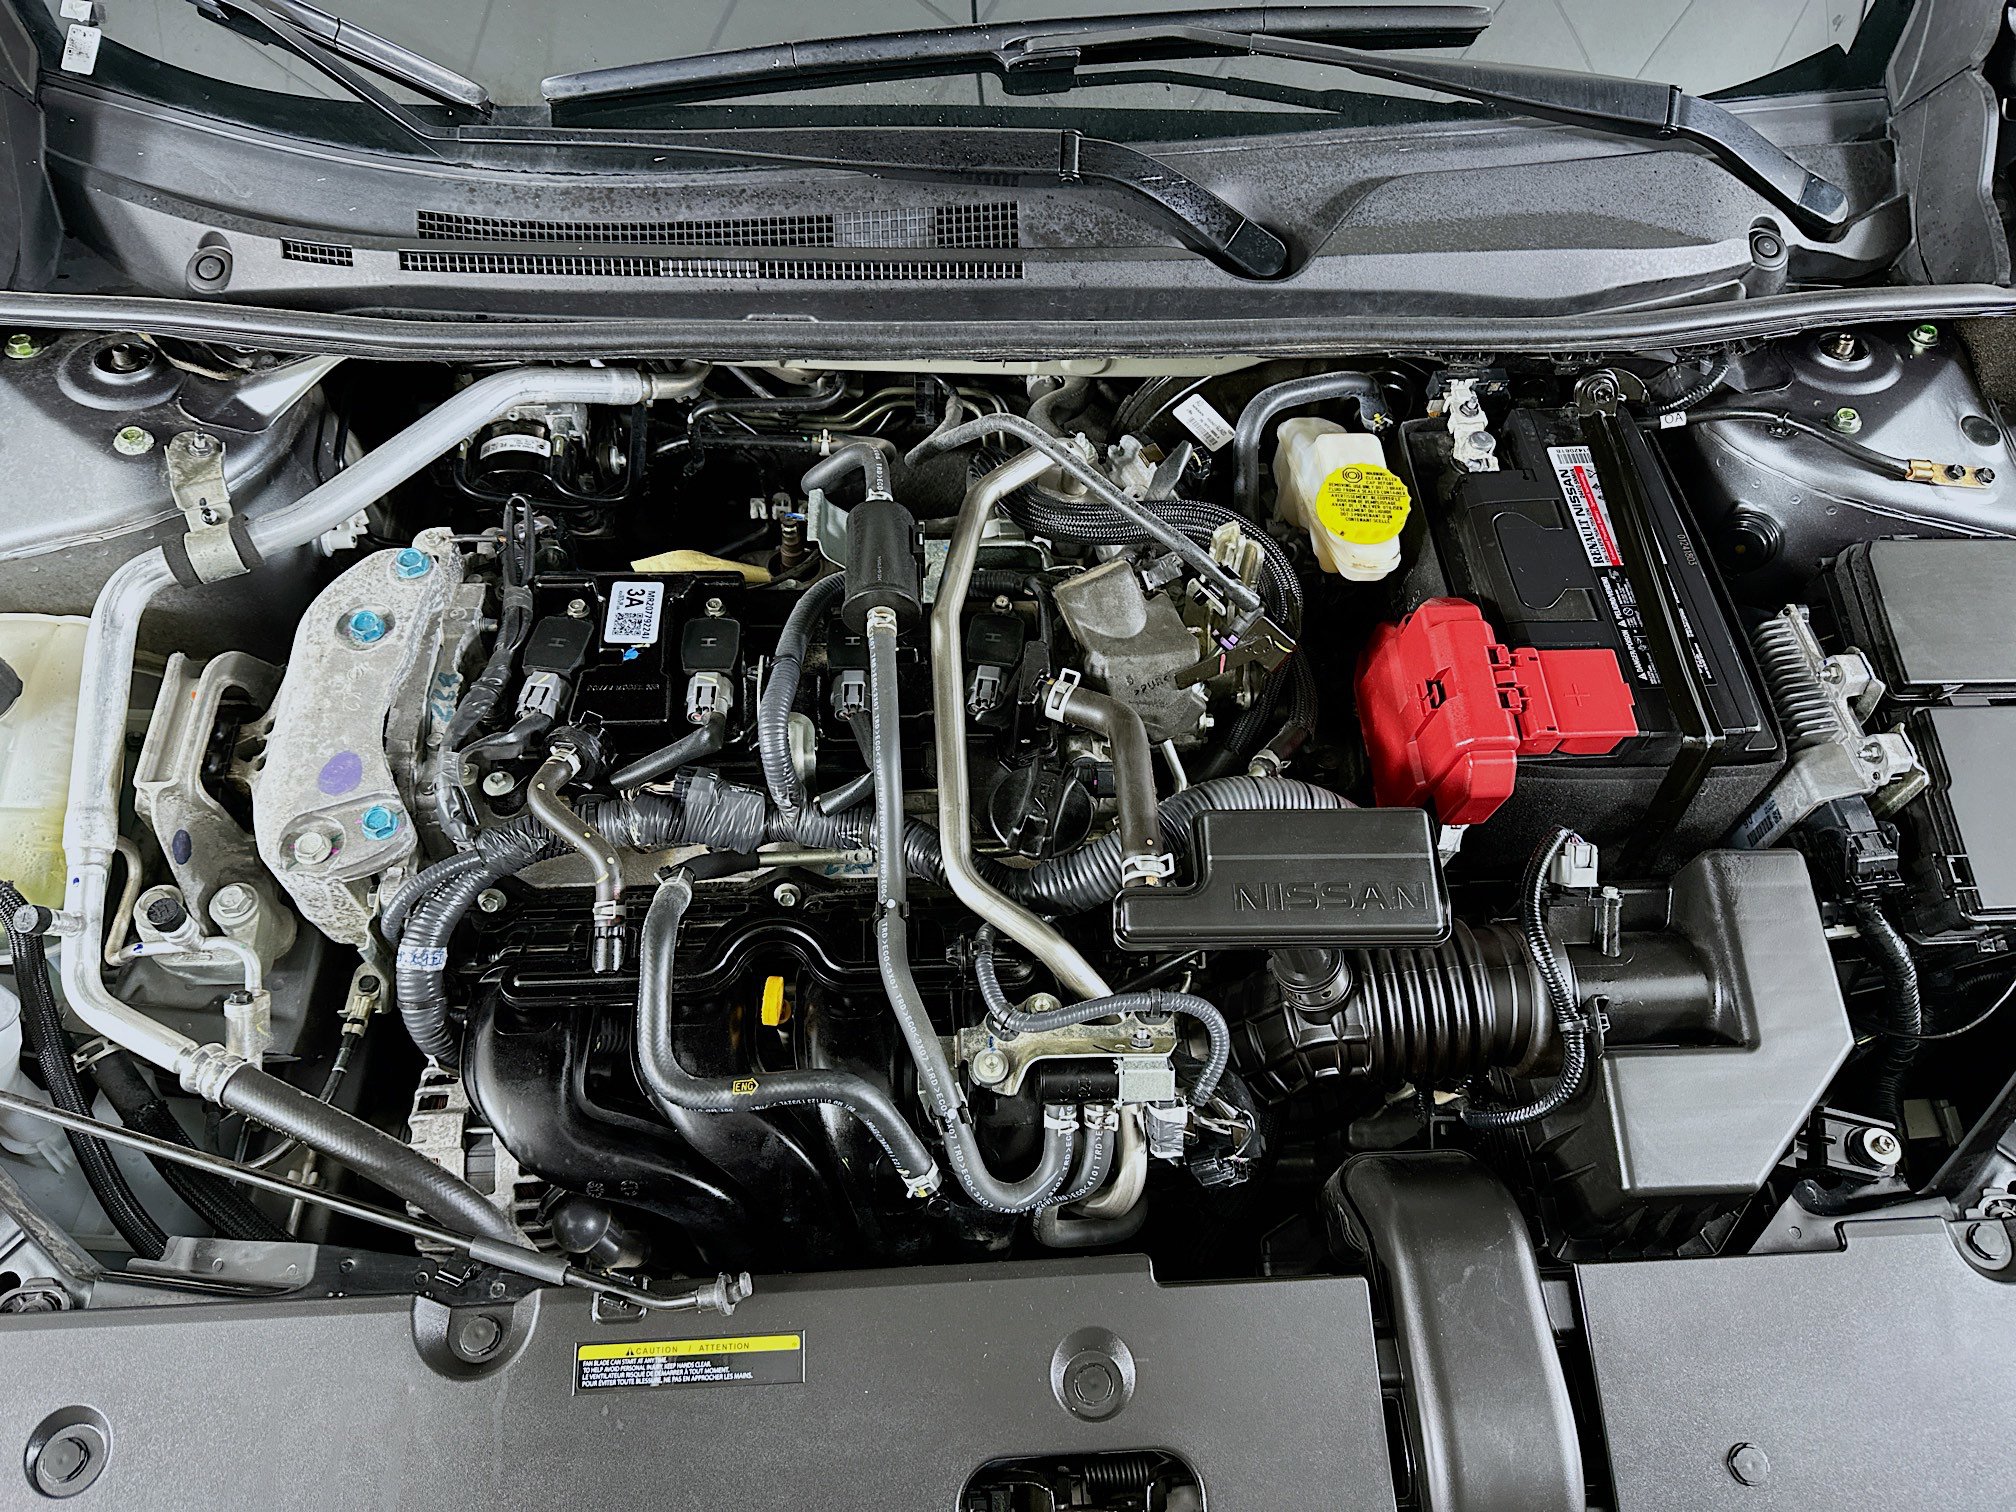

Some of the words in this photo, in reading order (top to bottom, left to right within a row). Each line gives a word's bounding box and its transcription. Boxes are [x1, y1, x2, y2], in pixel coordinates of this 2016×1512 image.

[1558, 468, 1584, 516] NISSAN
[1577, 518, 1604, 564] RENAULT
[625, 588, 646, 608] 3A
[1232, 881, 1430, 912] NISSAN
[735, 1081, 754, 1092] ENG
[635, 1345, 678, 1355] CAUTION
[698, 1341, 749, 1352] ATTENTION
[688, 1367, 703, 1375] TOUT
[723, 1372, 733, 1380] LES
